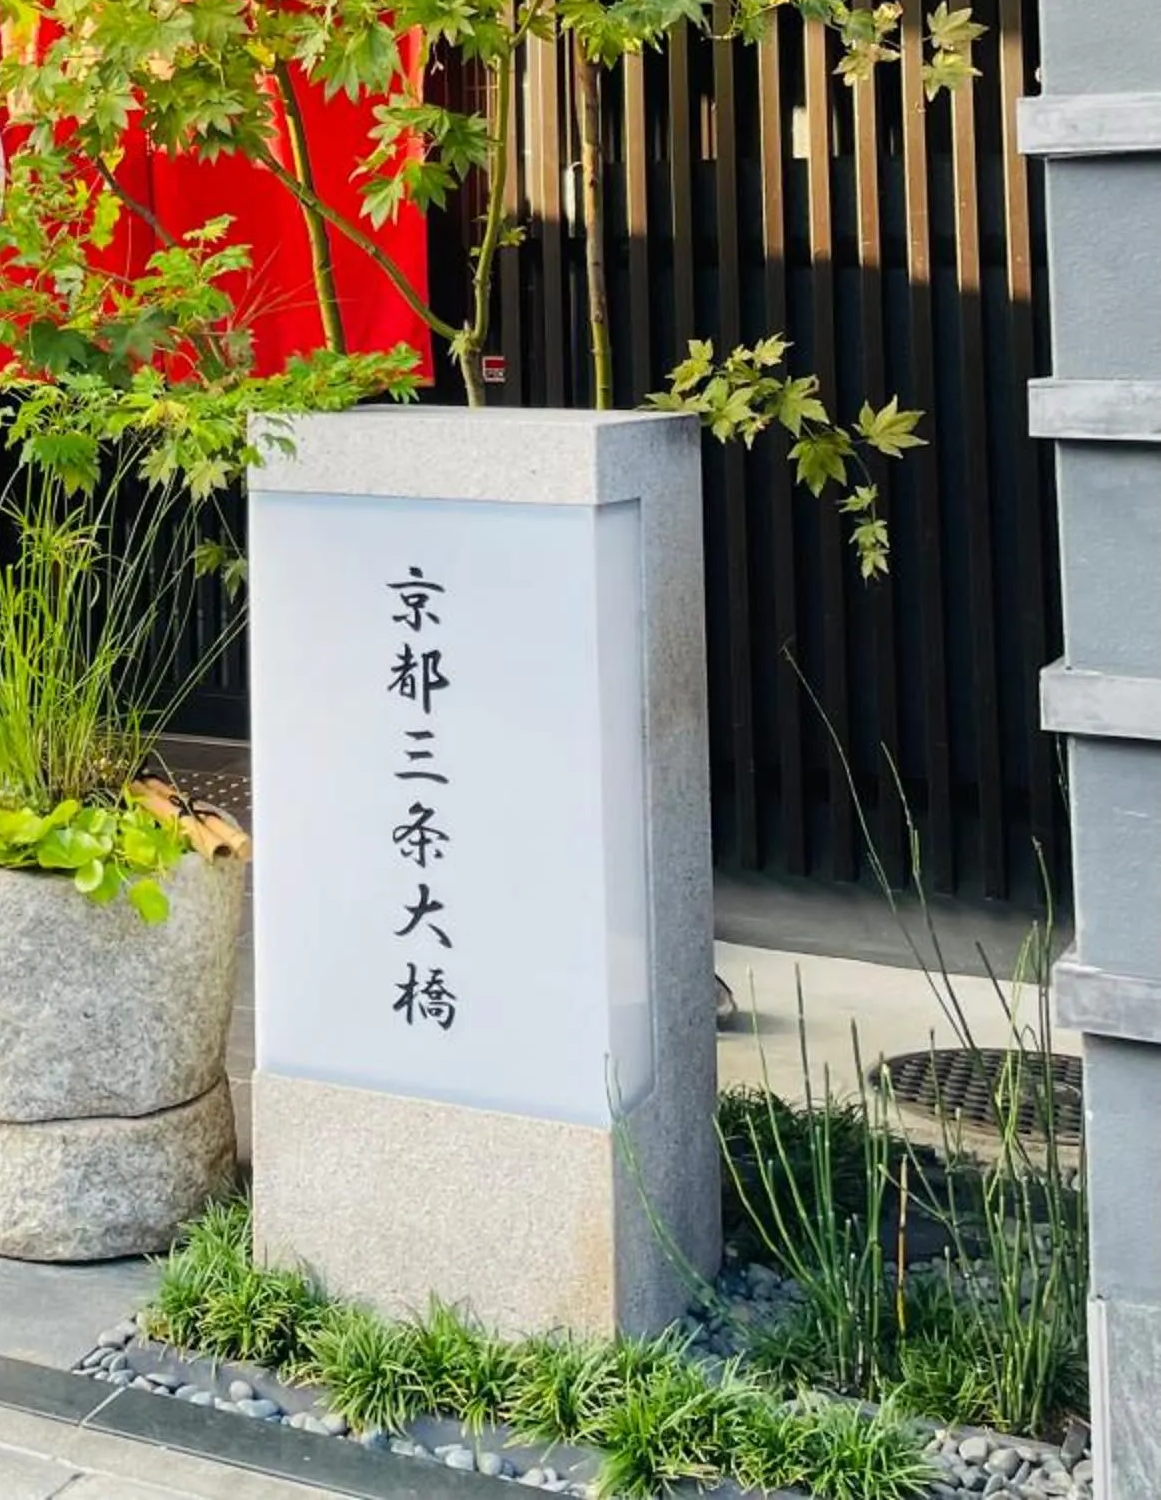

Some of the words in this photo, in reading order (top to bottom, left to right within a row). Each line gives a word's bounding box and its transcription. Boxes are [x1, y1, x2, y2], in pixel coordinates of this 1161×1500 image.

[386, 566, 457, 1031] 京都三条大橋
